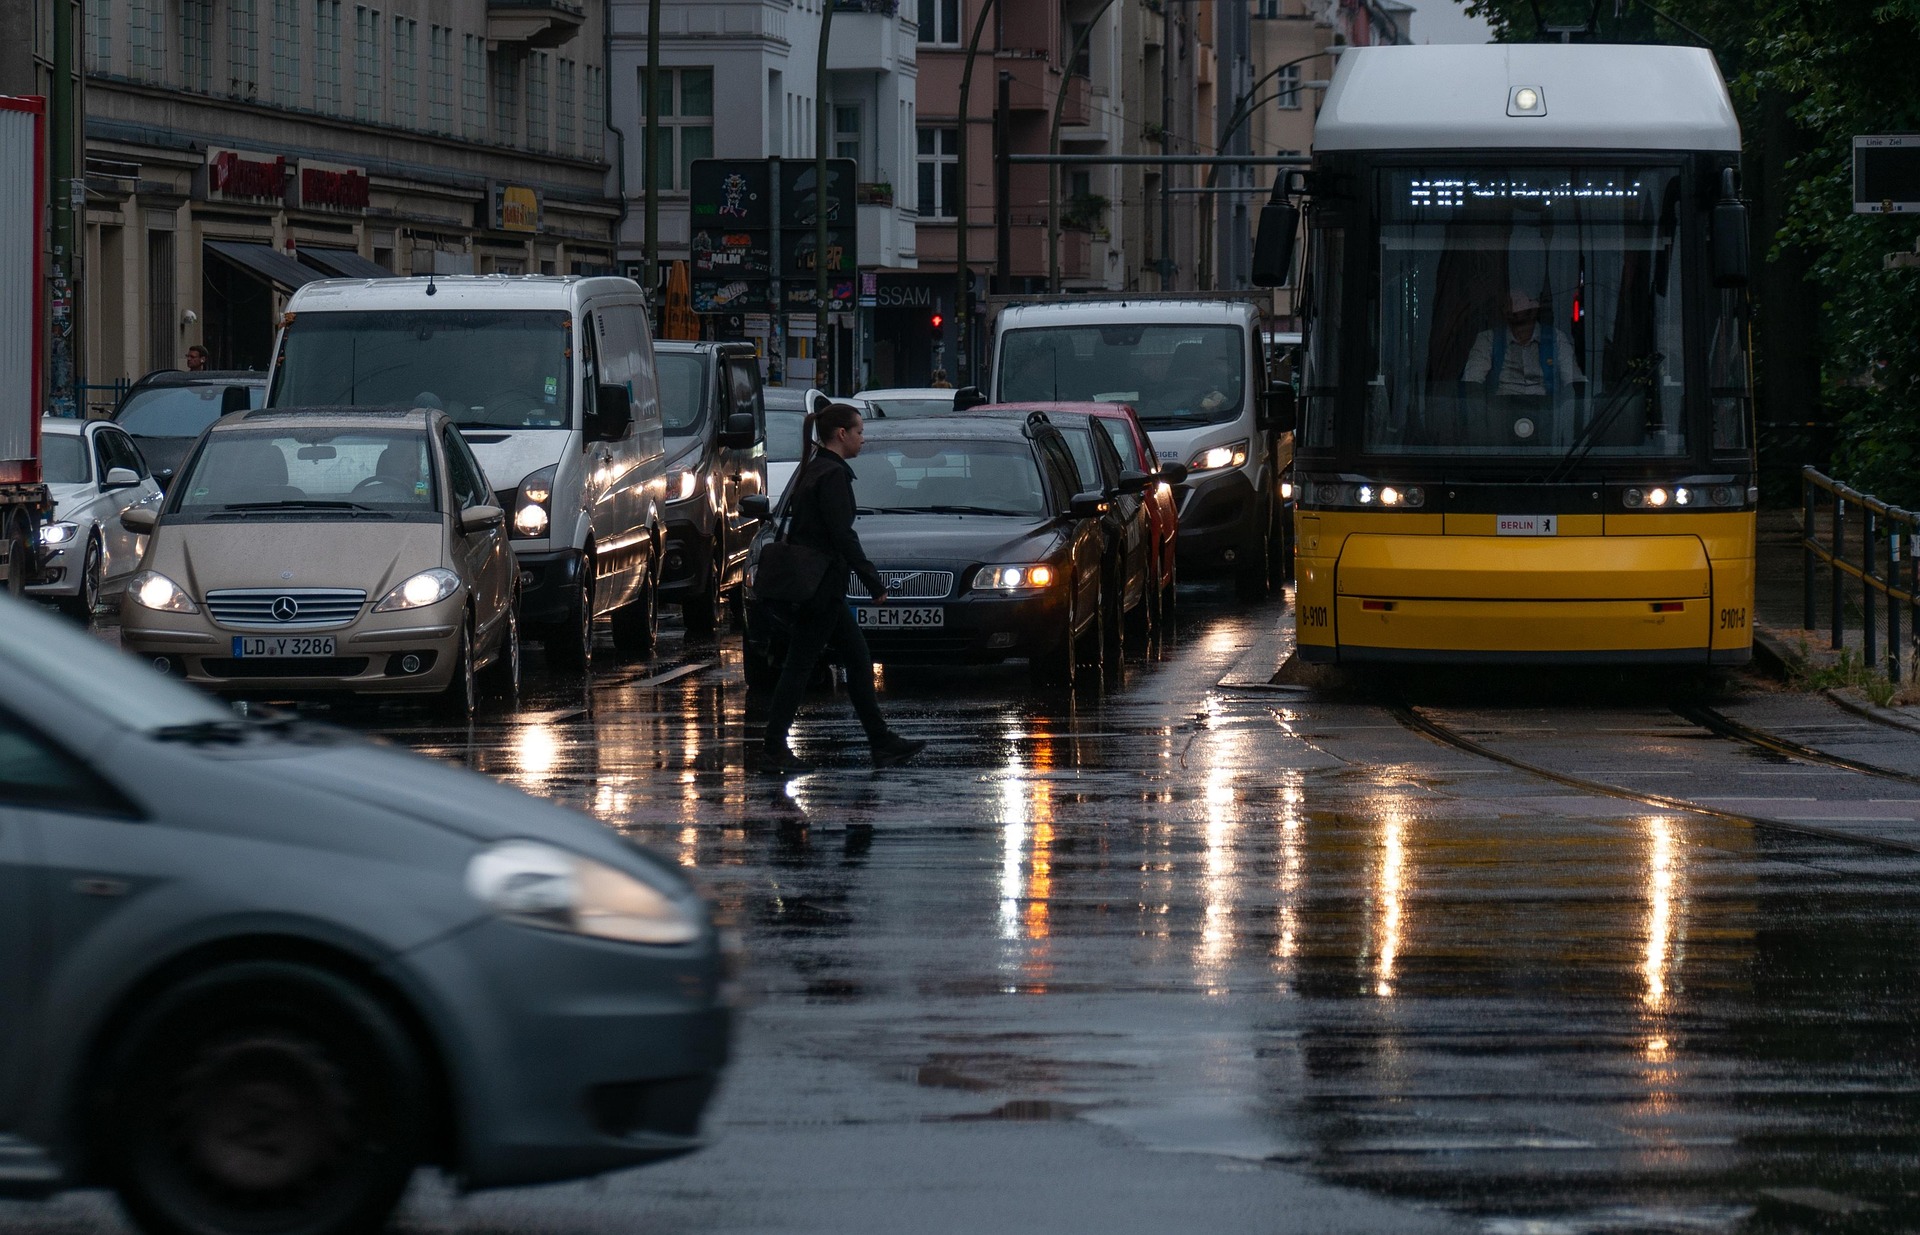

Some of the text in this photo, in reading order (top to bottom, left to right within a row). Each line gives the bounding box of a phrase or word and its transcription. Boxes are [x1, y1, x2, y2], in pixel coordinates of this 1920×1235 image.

[1889, 138, 1902, 146] Ziel
[878, 286, 931, 306] SSAM
[1500, 520, 1534, 531] BERLIN
[857, 608, 942, 624] B EM 2636
[1720, 607, 1746, 629] 9101-B
[244, 638, 333, 655] LD Y 3286
